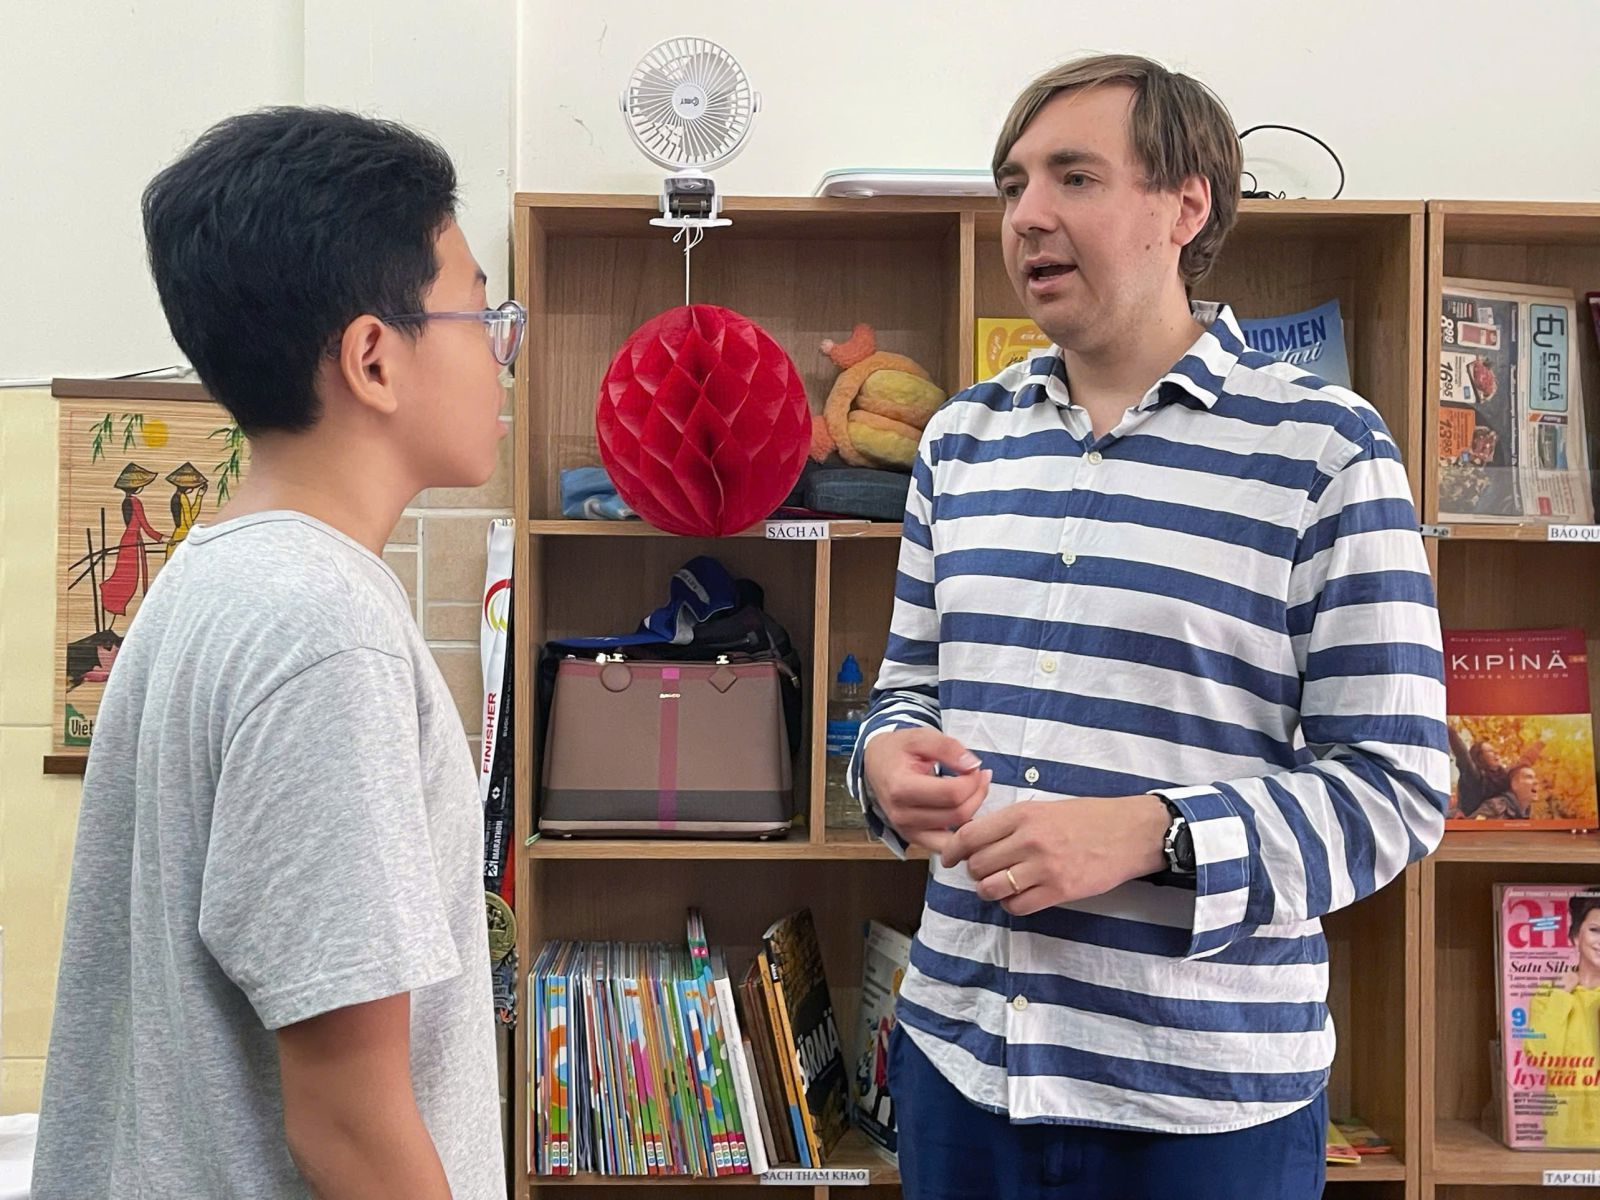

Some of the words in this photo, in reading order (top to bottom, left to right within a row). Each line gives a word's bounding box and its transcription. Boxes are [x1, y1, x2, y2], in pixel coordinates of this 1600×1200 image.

[1243, 315, 1327, 354] UOMEN
[1547, 352, 1564, 401] ETELÄ
[768, 524, 806, 538] SÁCH
[1451, 647, 1568, 671] KIPINÄ
[482, 692, 497, 774] FINISHER
[492, 820, 503, 860] MARATHON
[1509, 961, 1542, 973] Satu
[1511, 1007, 1527, 1027] 9
[1513, 1049, 1595, 1069] Voimaa
[1513, 1067, 1577, 1090] hyvää
